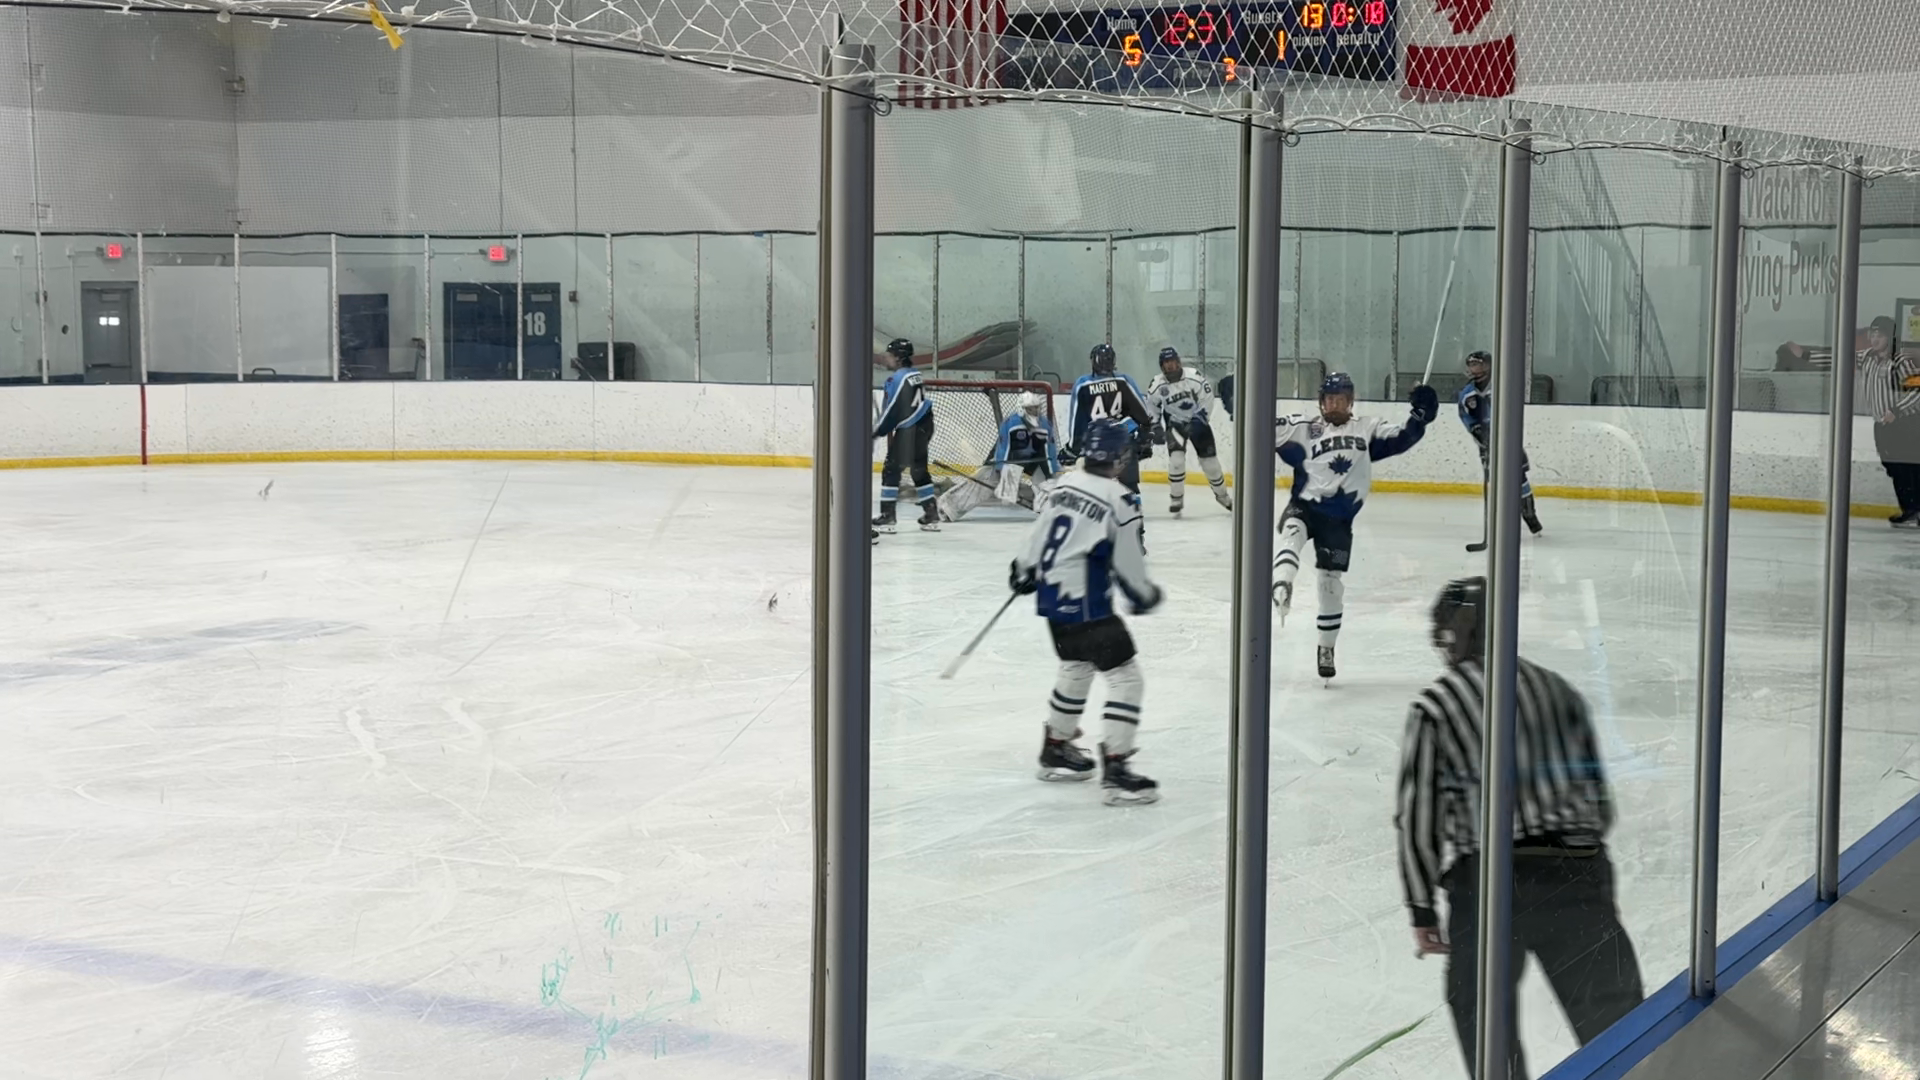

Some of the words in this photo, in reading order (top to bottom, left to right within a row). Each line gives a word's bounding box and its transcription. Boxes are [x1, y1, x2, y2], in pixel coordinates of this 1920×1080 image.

[1107, 16, 1137, 31] Home
[1244, 11, 1282, 25] Guests
[1303, 4, 1323, 28] 13
[1124, 33, 1142, 66] 5
[1292, 35, 1324, 50] player
[1336, 33, 1380, 47] penalty
[1223, 57, 1236, 81] 3
[1748, 166, 1801, 220] Watch
[1744, 241, 1783, 313] ying
[1789, 241, 1839, 295] Pucks
[524, 311, 546, 336] 18
[1089, 381, 1118, 395] MARTIN
[1090, 391, 1123, 421] 44
[1311, 436, 1367, 460] LEAFS
[1041, 514, 1073, 571] 8
